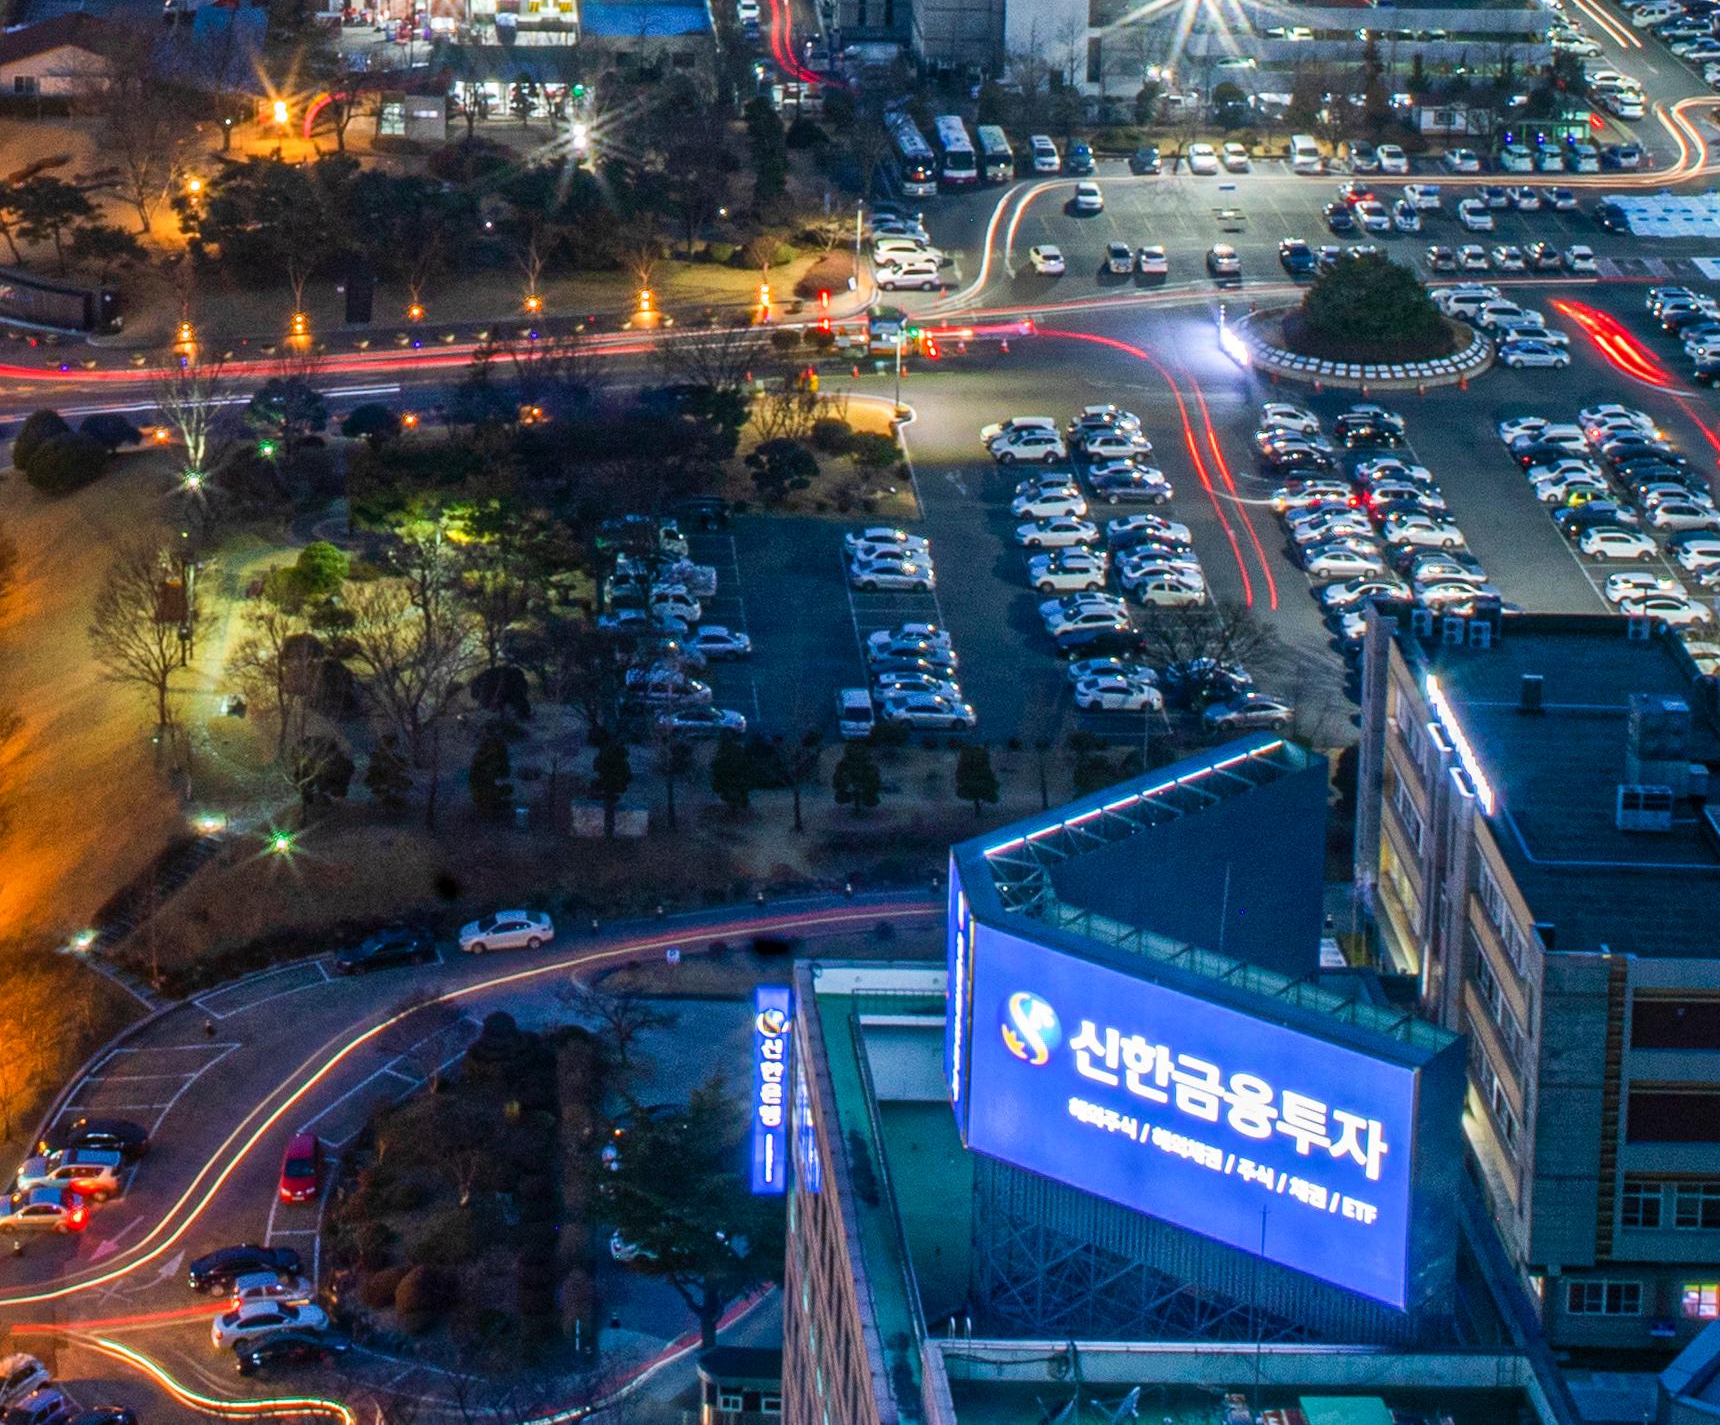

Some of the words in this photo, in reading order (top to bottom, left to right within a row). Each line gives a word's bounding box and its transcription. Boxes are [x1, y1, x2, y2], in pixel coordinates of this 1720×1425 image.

[1069, 1020, 1388, 1181] 신한금융투자
[1237, 1158, 1275, 1190] 주식
[1341, 1196, 1378, 1224] ETF
